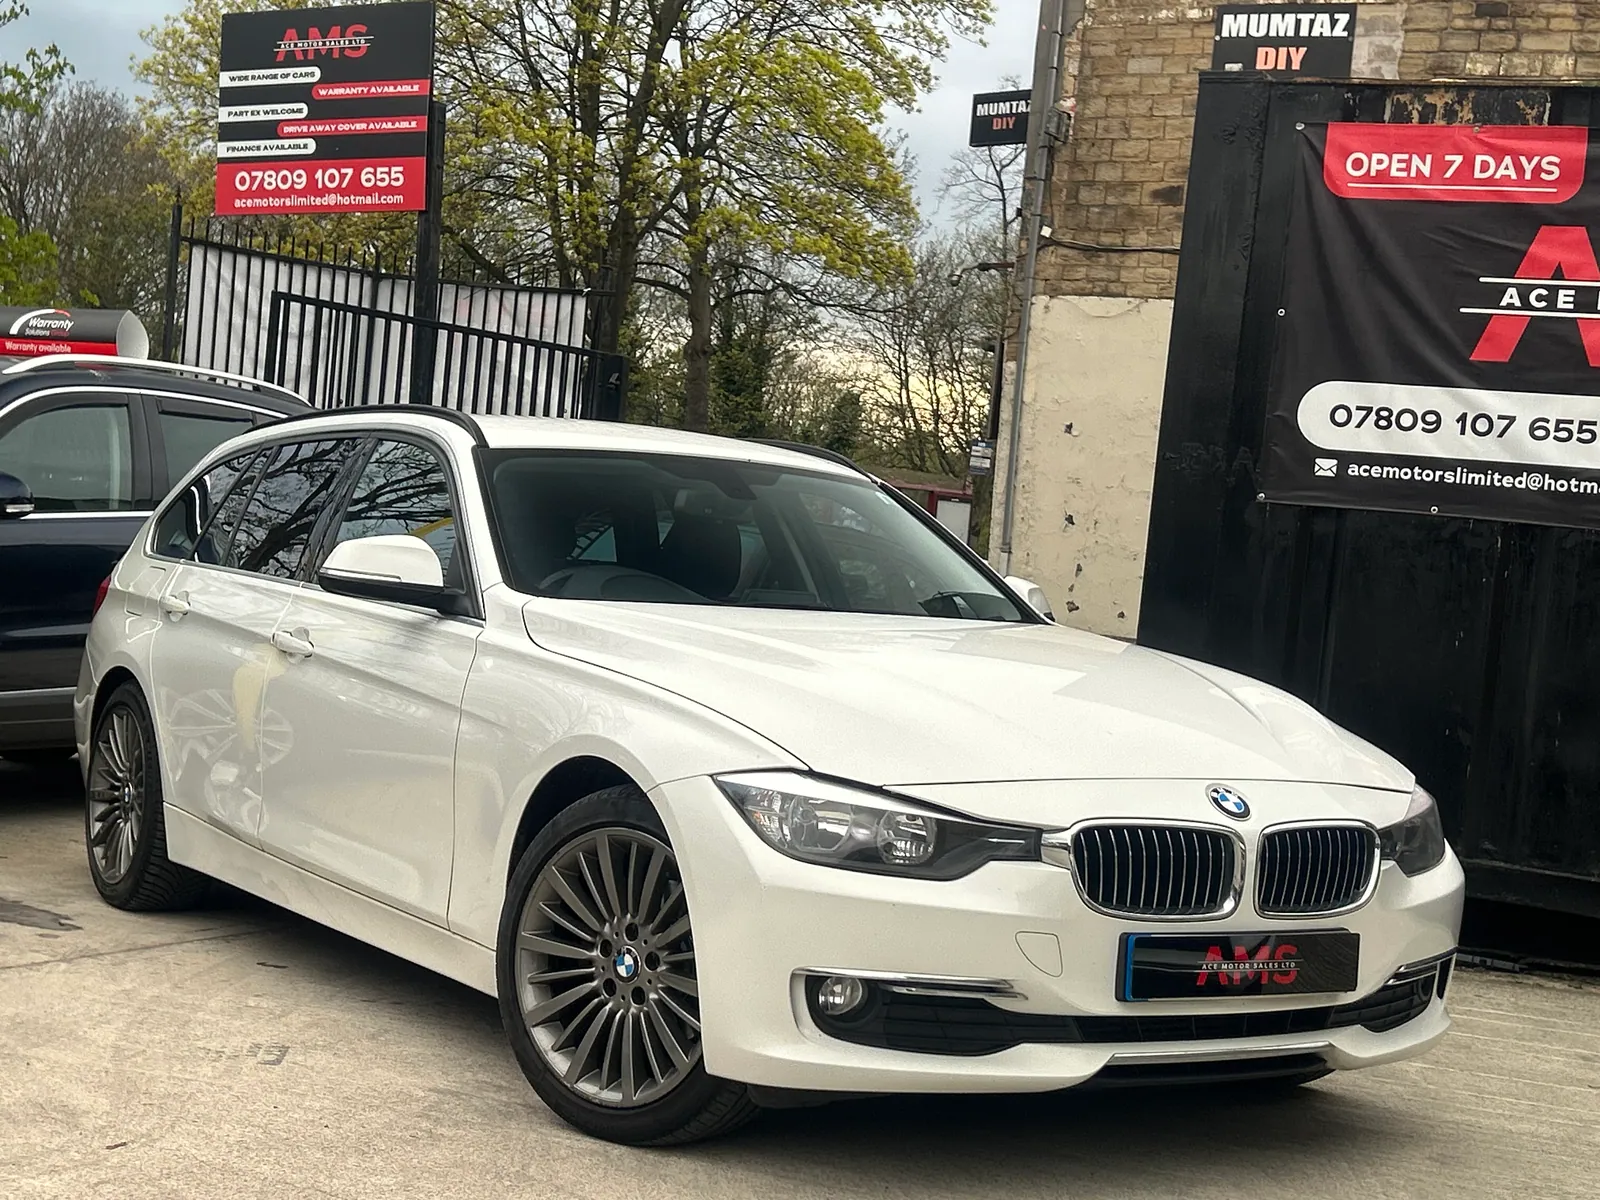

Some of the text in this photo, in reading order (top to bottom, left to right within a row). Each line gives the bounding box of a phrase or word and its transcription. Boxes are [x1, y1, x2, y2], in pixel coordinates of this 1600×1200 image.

[1221, 13, 1350, 38] MUMTAZ
[276, 23, 368, 61] AMS
[1256, 46, 1307, 70] DIY
[229, 74, 249, 82] WIDE
[251, 73, 279, 81] RANGE
[292, 71, 316, 79] CARS
[318, 84, 420, 96] WARRANTY AVAILABLE
[263, 108, 304, 116] WELCOME
[283, 121, 417, 133] DRIVE AWAY COVER AVAILABLE
[992, 116, 1016, 130] DIY
[226, 143, 309, 153] FINANCE AVAILABLE
[1345, 152, 1561, 181] OPEN 7 DAYS
[234, 166, 405, 191] 07809 107 655
[234, 192, 404, 208] acemotorslimited@hotmail.com
[1499, 287, 1576, 309] ACE
[29, 317, 74, 332] Warranty
[5, 341, 72, 354] Warranty available
[1329, 404, 1598, 444] 07809 107 655
[1347, 463, 1600, 494] acemotorslimited@hotm
[1196, 944, 1297, 986] AMS
